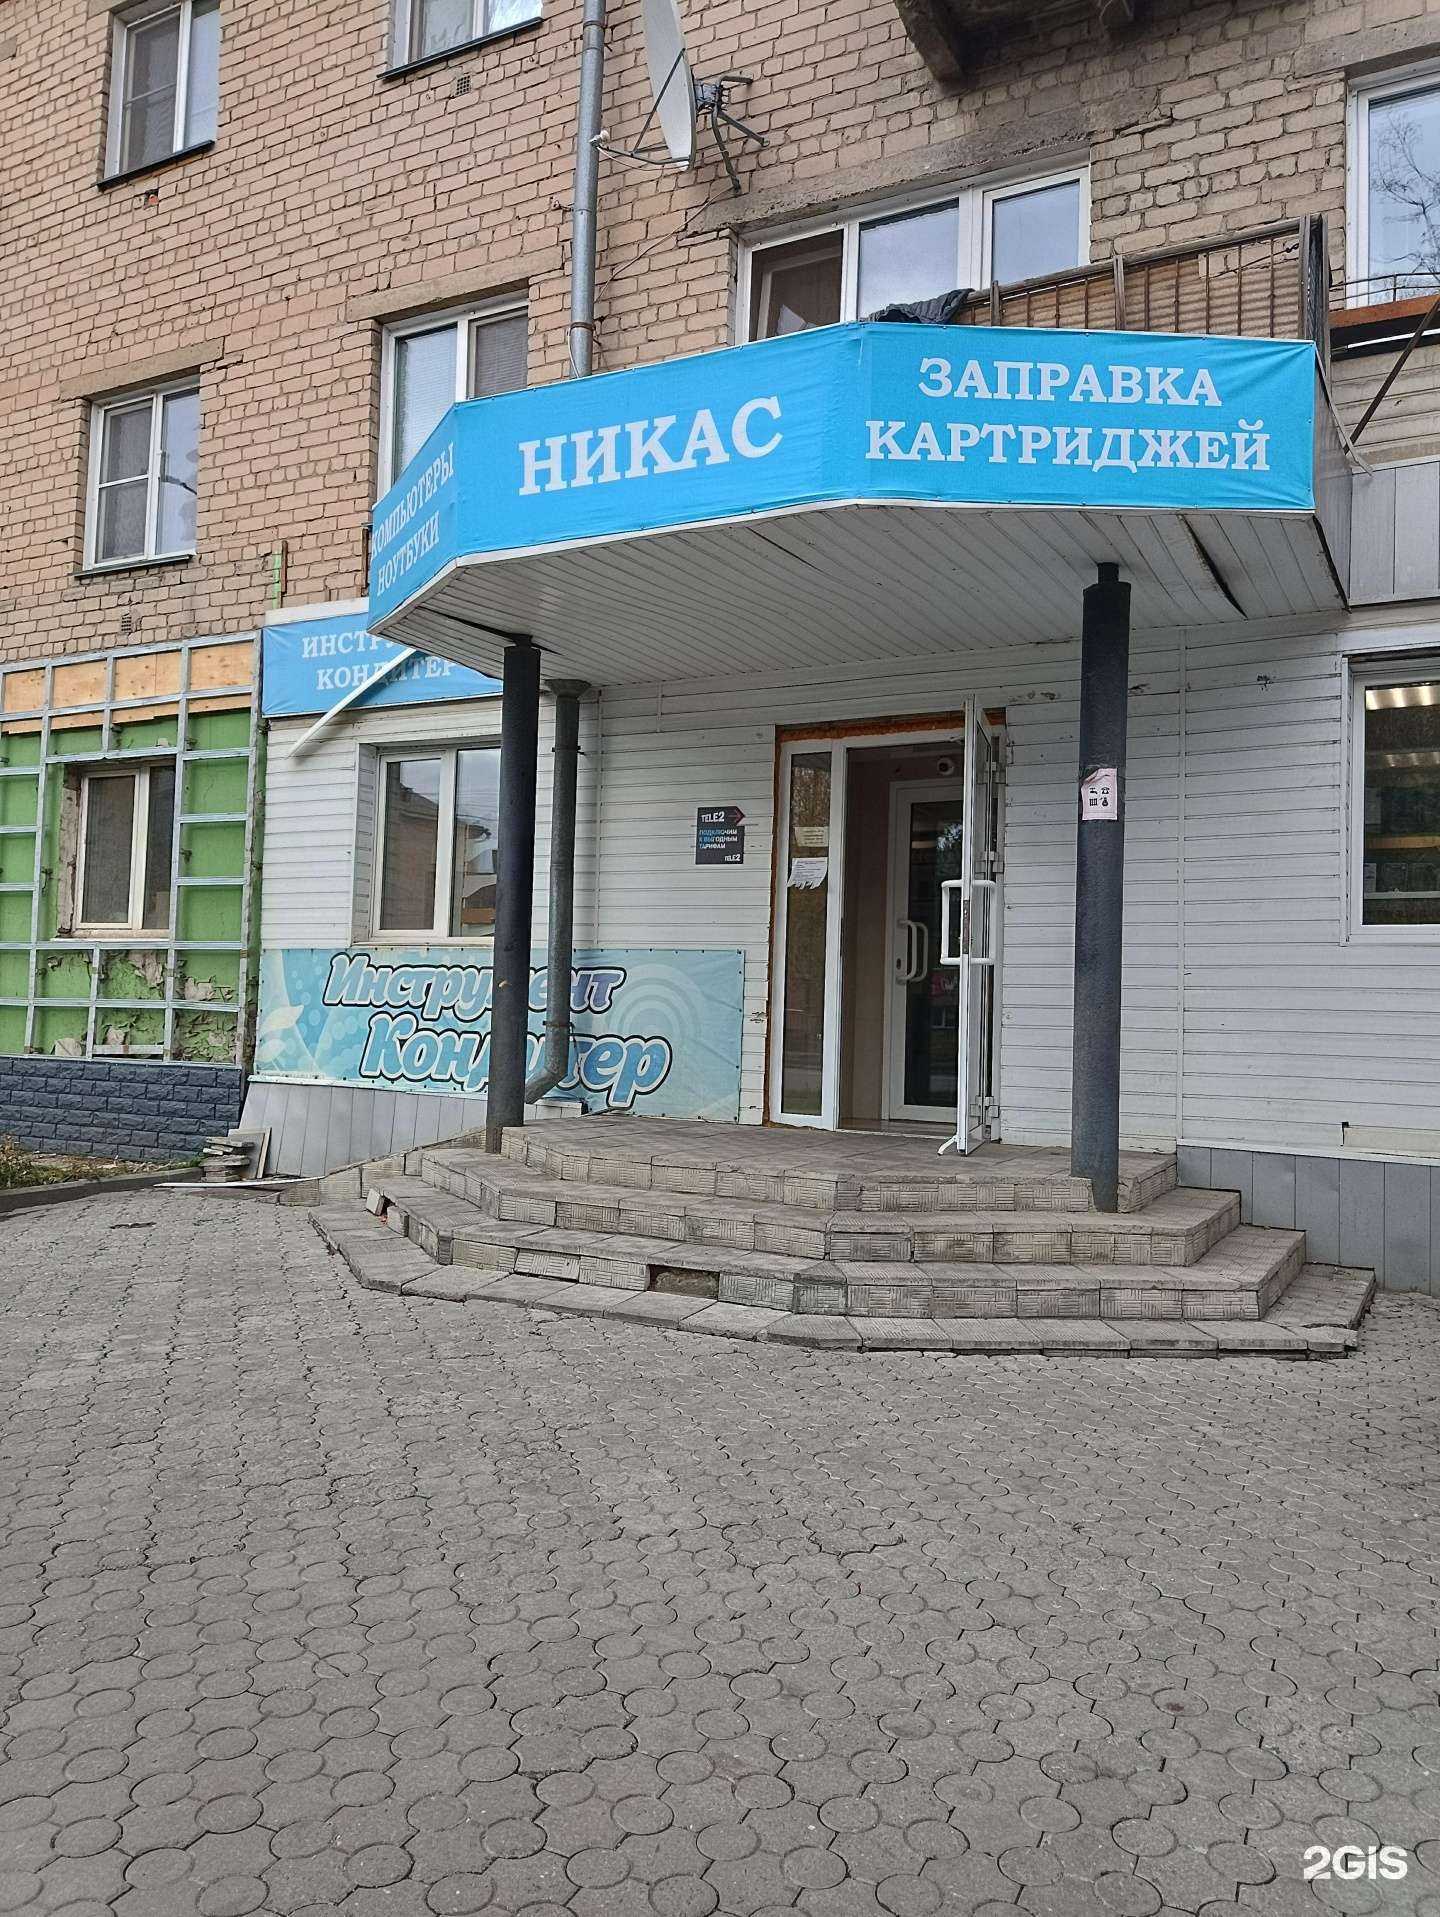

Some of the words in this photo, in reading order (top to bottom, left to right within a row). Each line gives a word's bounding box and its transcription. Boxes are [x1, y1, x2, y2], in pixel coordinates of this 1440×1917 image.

[918, 357, 1223, 407] ЗАПРАВКА
[518, 396, 783, 496] НИКАС
[864, 418, 1272, 473] КАРТРИДЖЕЙ
[371, 442, 455, 561] КОМПЬЮТЕРЫ
[376, 512, 440, 597] НОУТБУКИ
[701, 811, 725, 823] TELE2
[724, 853, 741, 862] TELE2
[322, 952, 626, 1022] Инструент
